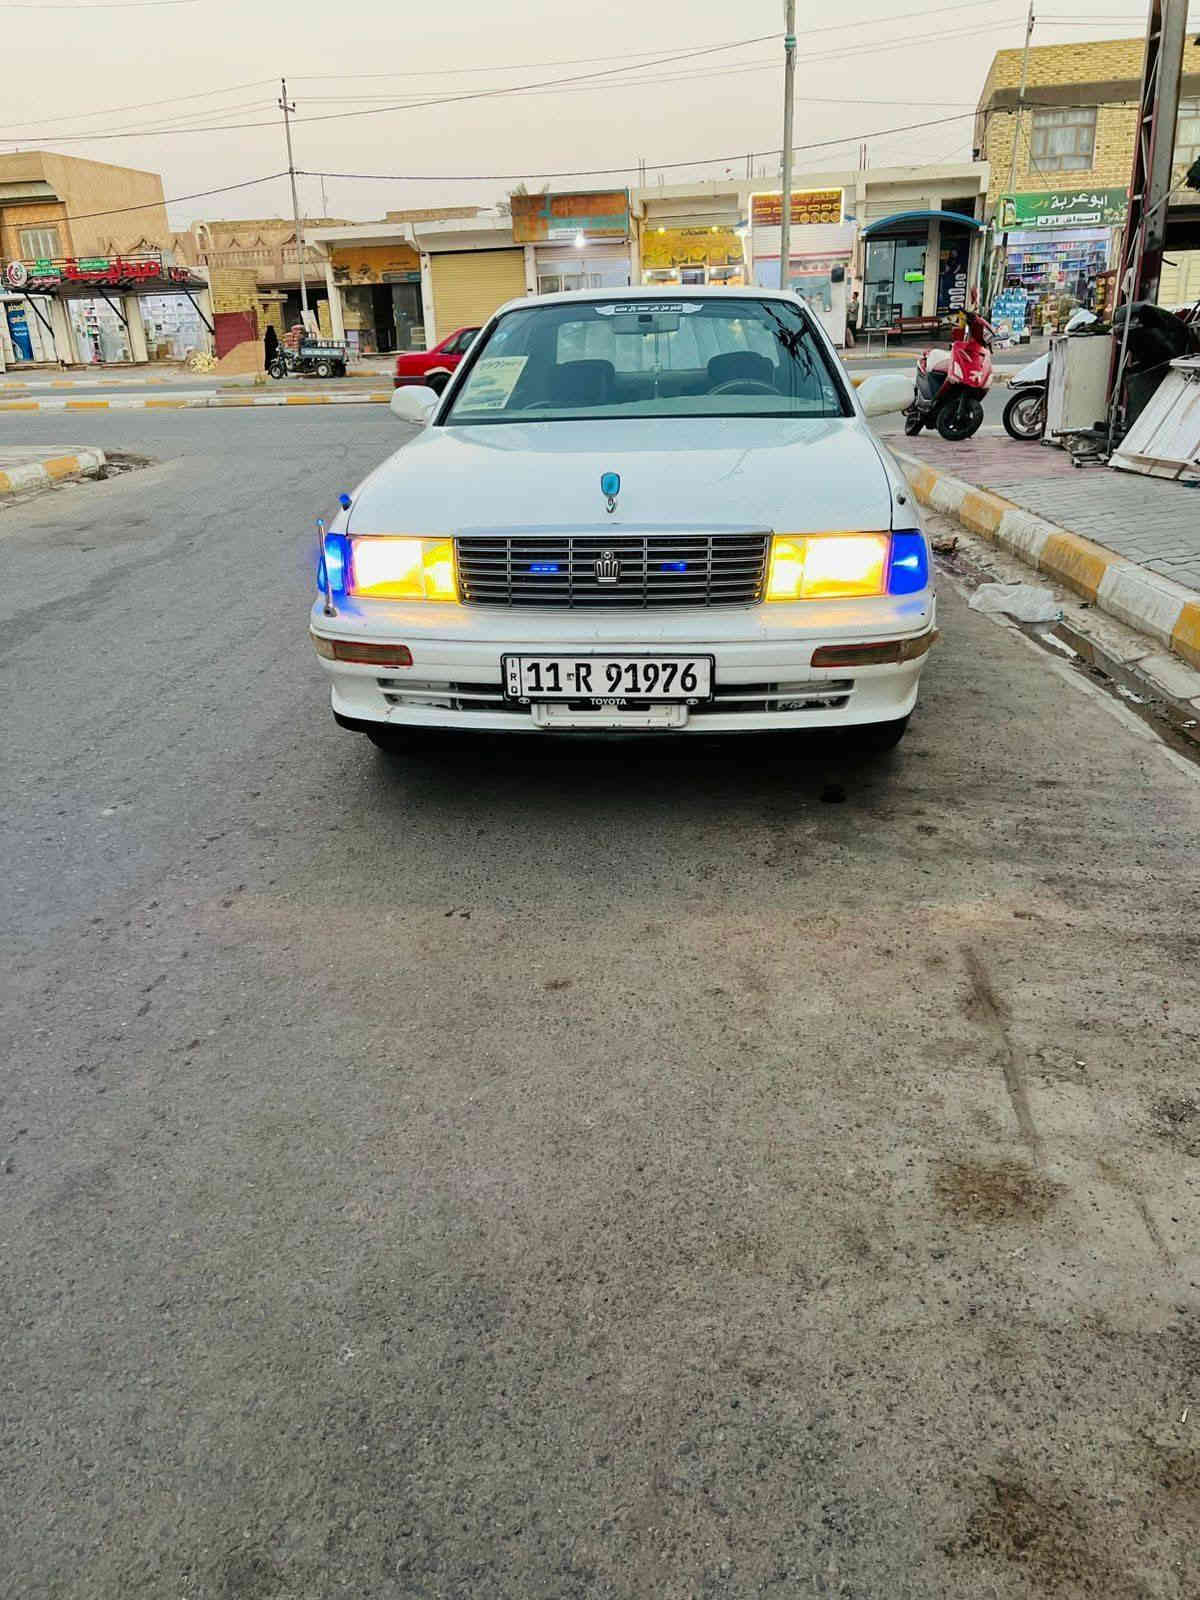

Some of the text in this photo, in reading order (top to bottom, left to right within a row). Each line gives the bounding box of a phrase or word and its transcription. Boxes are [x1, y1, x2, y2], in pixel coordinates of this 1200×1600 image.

[526, 662, 698, 693] 11 R 91976
[590, 697, 627, 706] TOYOTA
